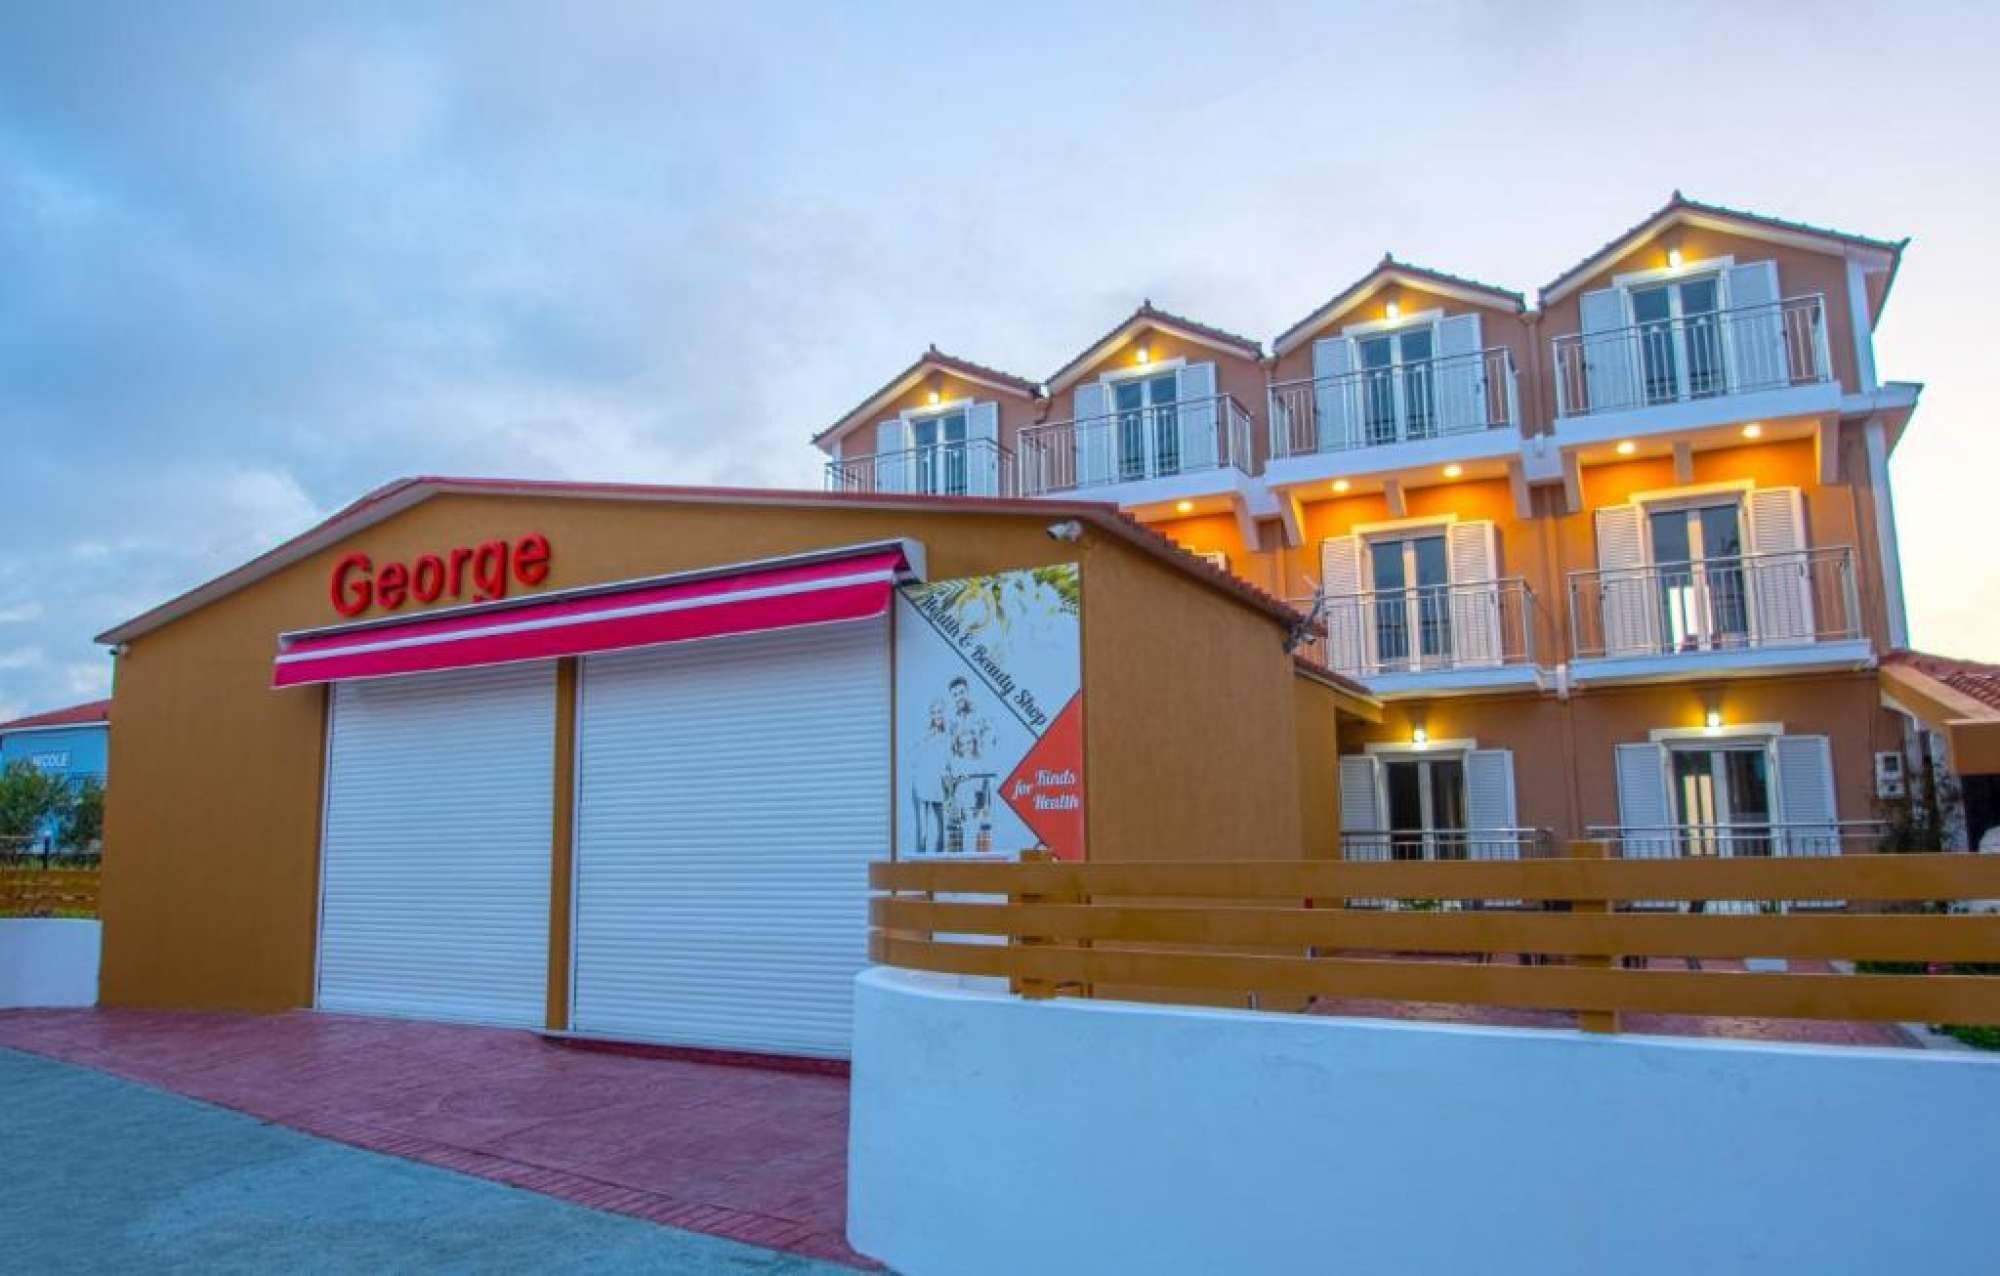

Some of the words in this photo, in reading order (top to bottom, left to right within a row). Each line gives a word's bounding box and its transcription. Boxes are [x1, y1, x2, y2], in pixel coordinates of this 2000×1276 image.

[330, 531, 551, 618] George
[921, 595, 960, 638] Health
[959, 632, 973, 648] &
[970, 644, 1017, 698] Beauty
[1014, 689, 1048, 726] Shop
[32, 753, 69, 767] NICOLE
[1011, 780, 1033, 799] for
[1032, 793, 1079, 810] Health
